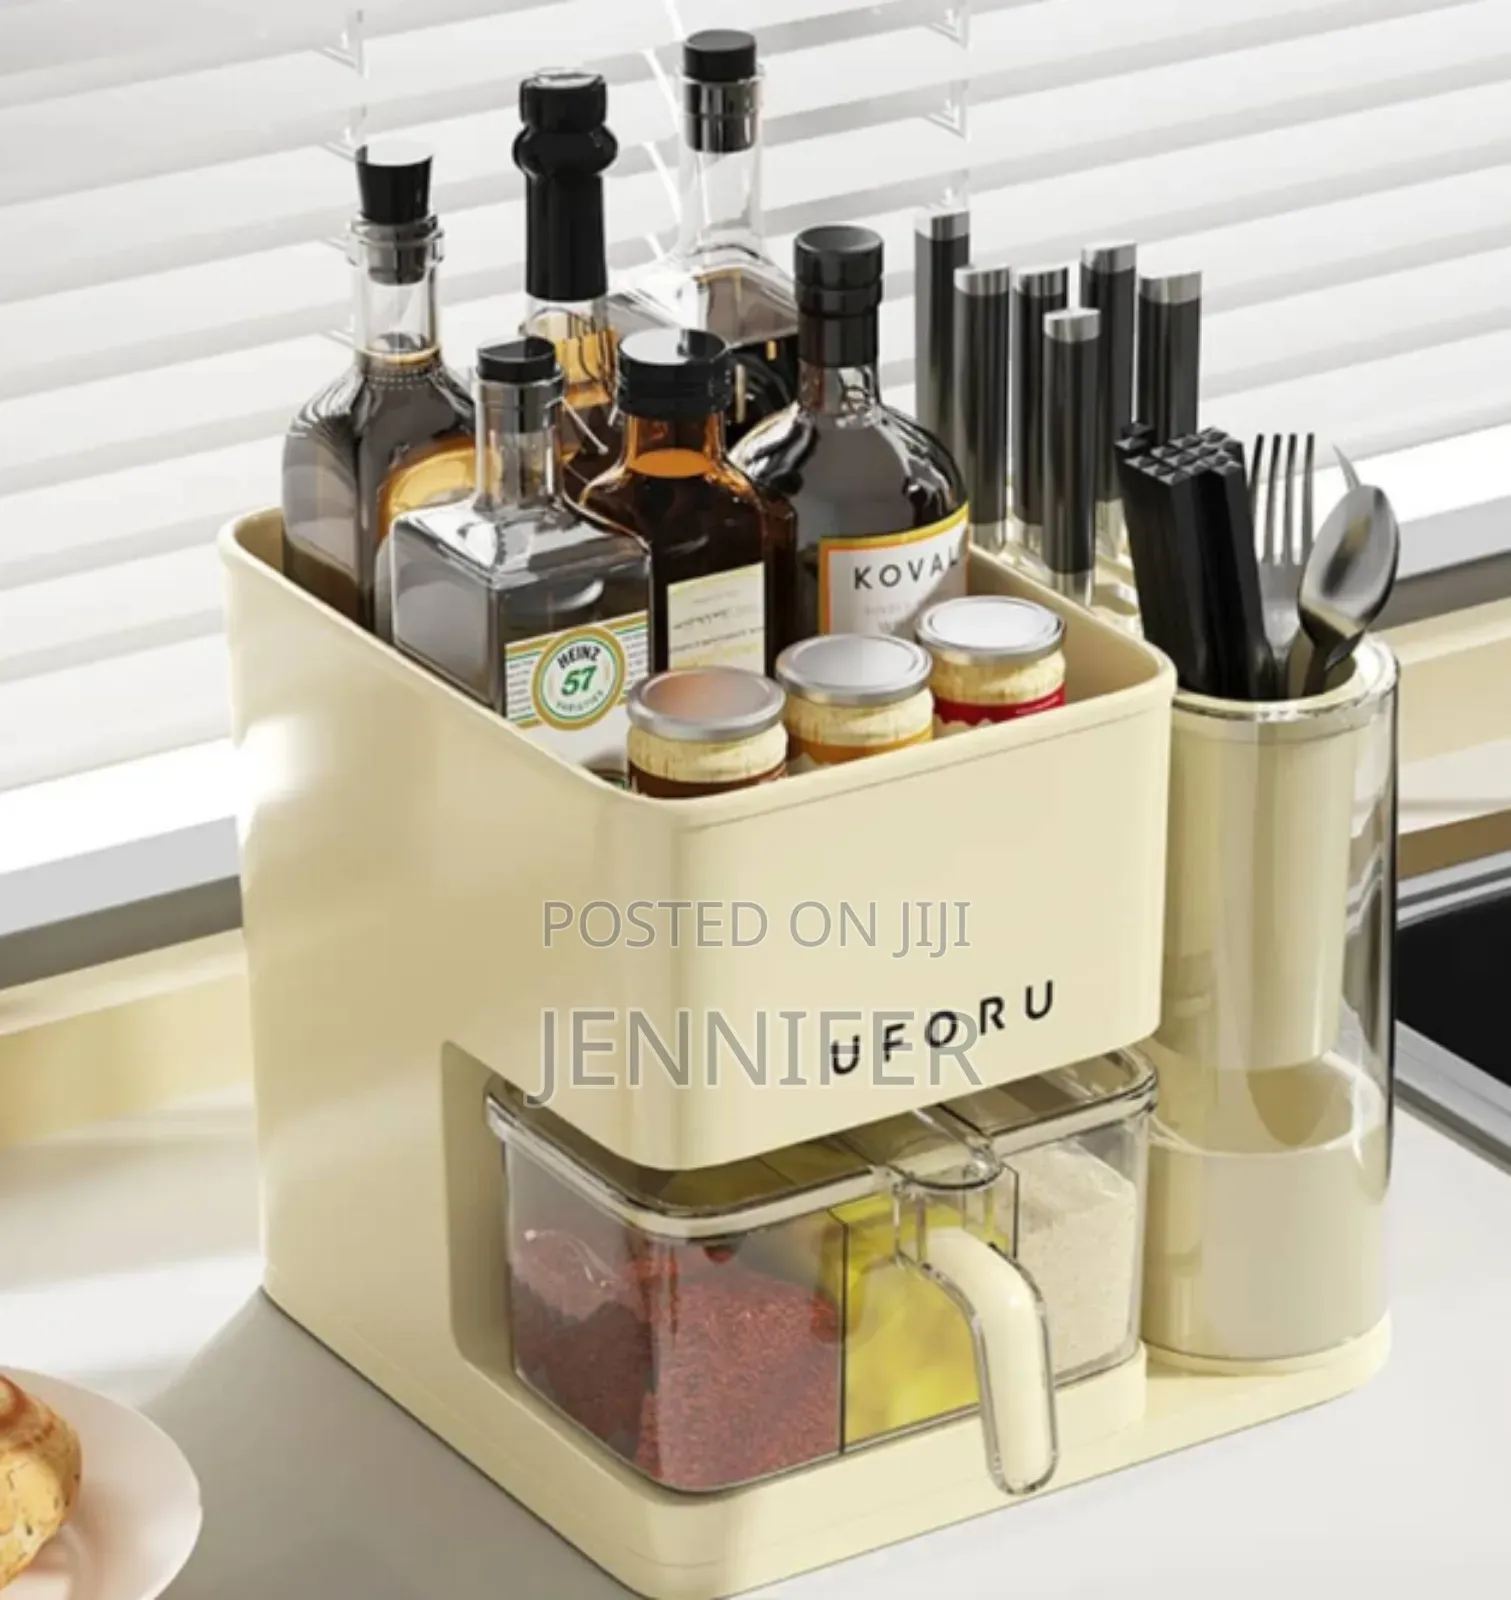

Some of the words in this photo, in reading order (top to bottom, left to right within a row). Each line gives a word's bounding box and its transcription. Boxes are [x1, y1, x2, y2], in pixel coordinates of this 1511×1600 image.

[854, 545, 959, 590] KOVAL
[556, 645, 601, 669] HEINZ
[561, 665, 597, 696] 57
[830, 979, 1055, 1076] UFORU
